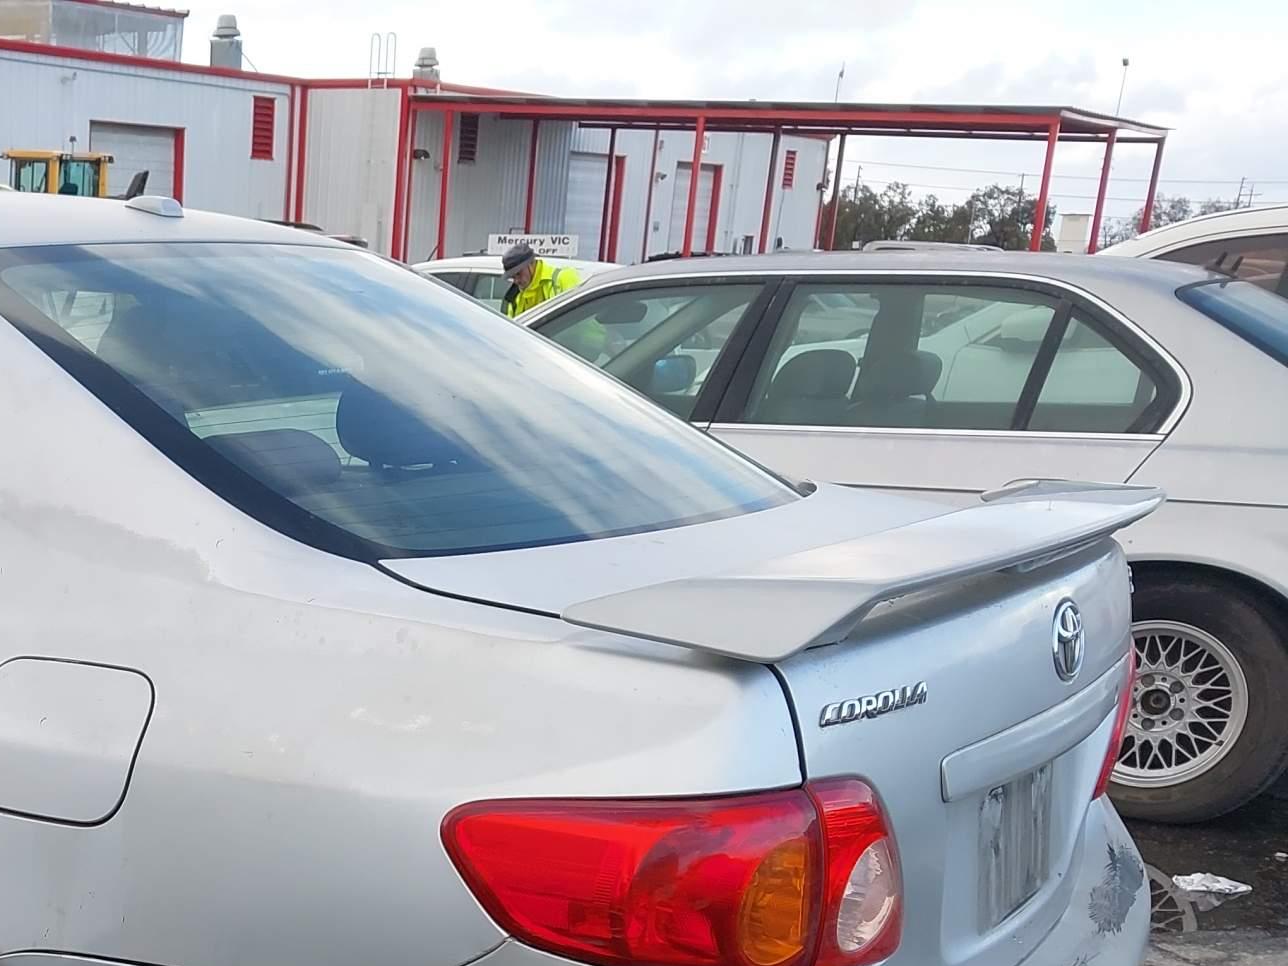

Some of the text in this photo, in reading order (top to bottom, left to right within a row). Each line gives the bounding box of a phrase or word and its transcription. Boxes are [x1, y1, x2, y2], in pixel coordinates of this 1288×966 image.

[497, 236, 570, 246] Mercury VIC
[818, 680, 928, 728] COROLLA
